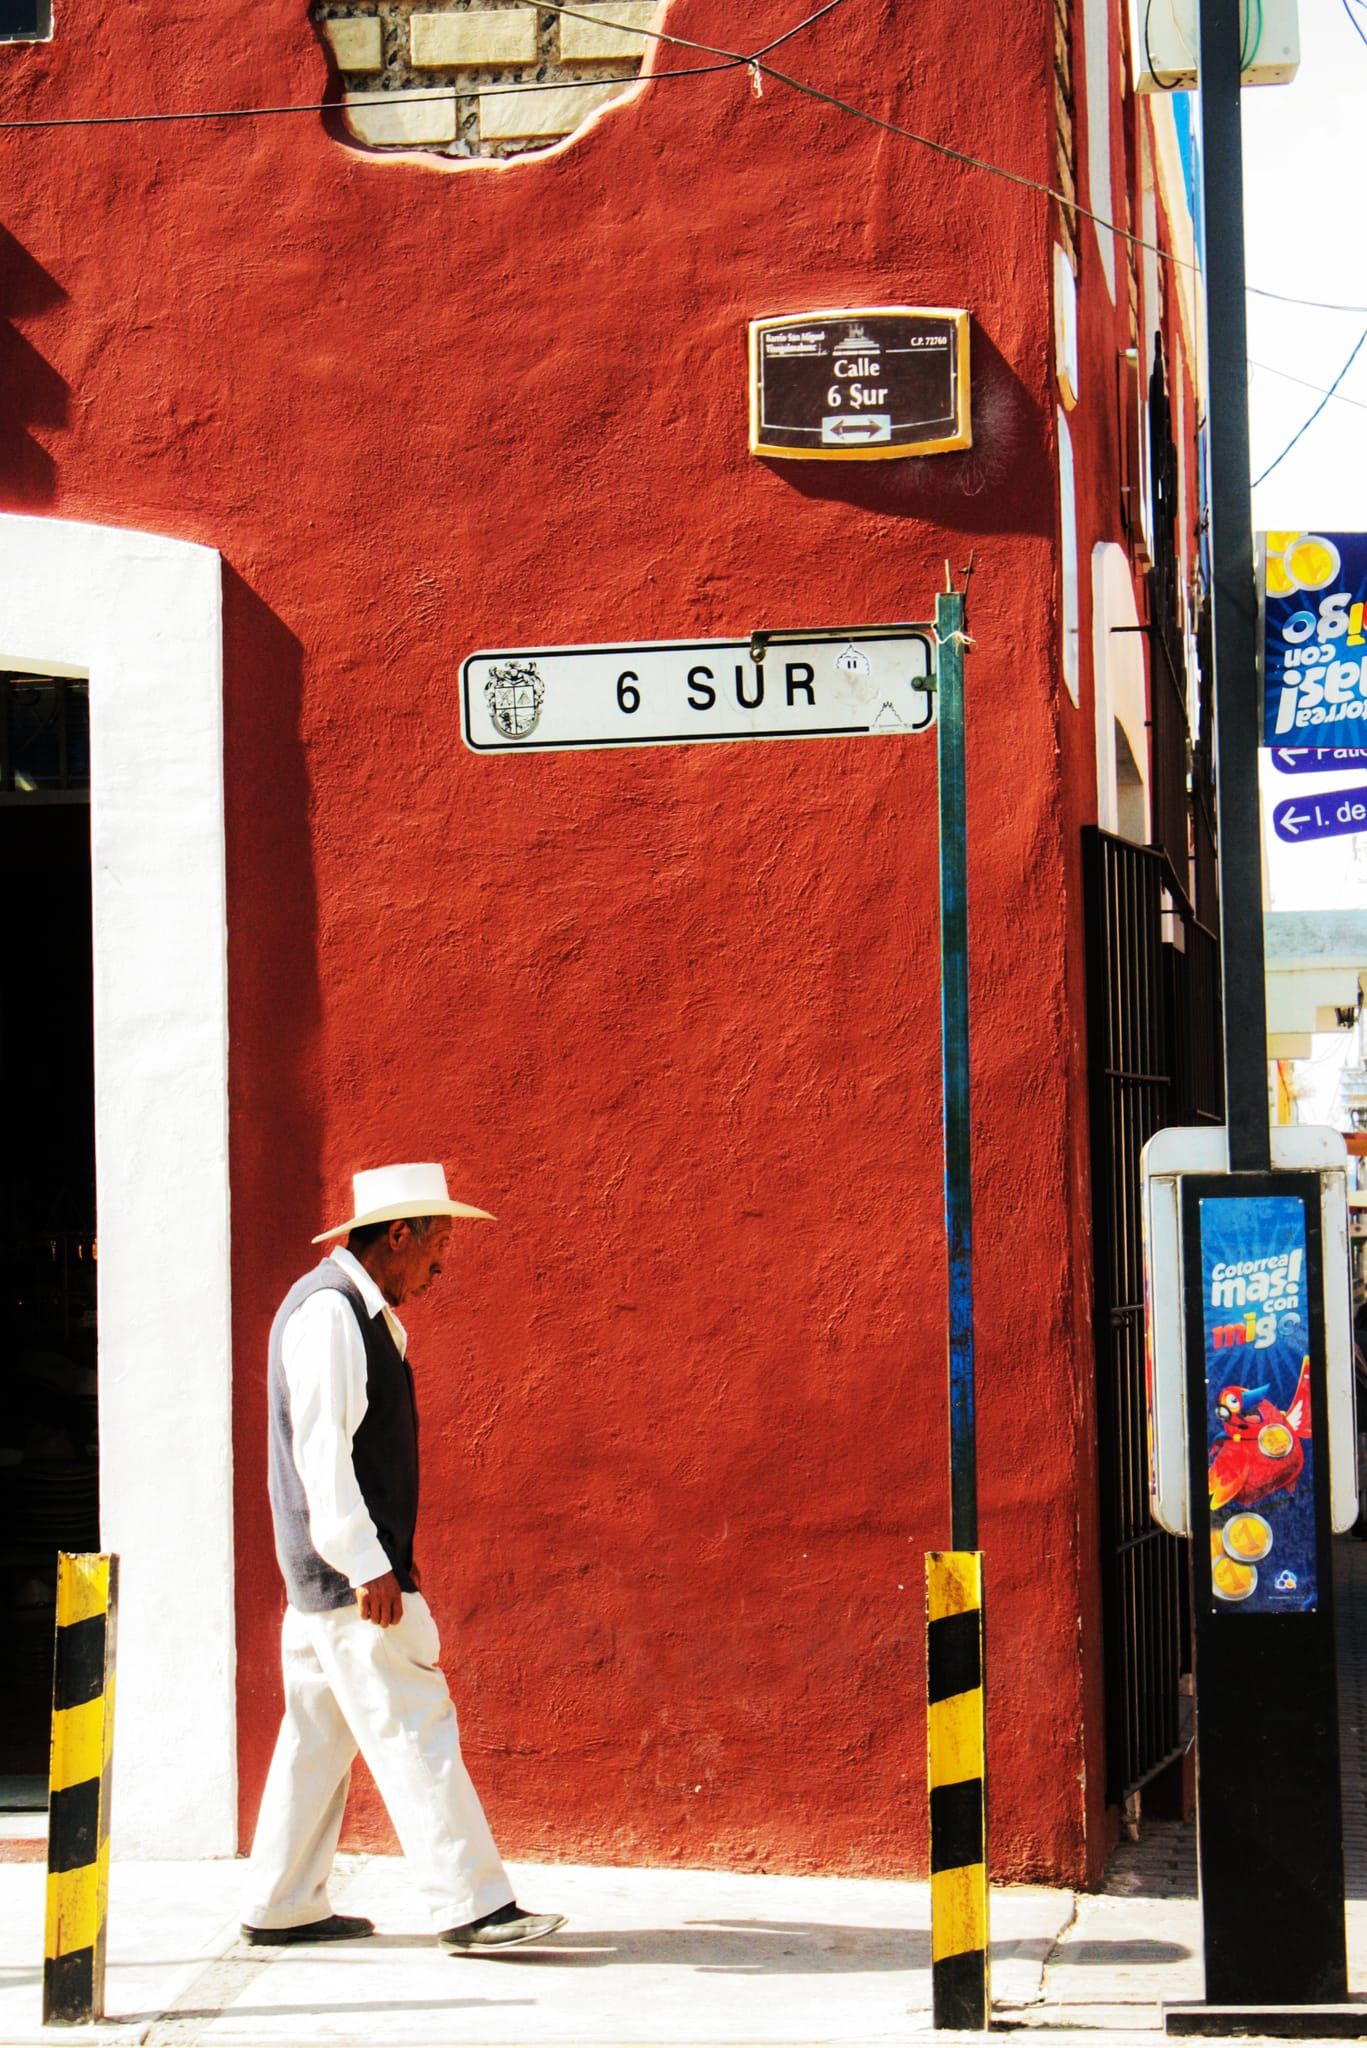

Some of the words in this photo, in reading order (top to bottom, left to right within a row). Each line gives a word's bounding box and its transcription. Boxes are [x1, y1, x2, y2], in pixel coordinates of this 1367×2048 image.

[833, 358, 881, 378] Calle
[827, 385, 842, 408] 6
[850, 383, 888, 409] Sur
[1282, 592, 1367, 647] igo
[1284, 644, 1337, 668] con
[616, 670, 641, 714] 6
[687, 662, 817, 711] SUR
[1274, 656, 1367, 735] as!
[1336, 800, 1367, 822] de
[1211, 1253, 1289, 1282] Cotorrea
[1211, 1248, 1303, 1308] mas!
[1263, 1295, 1299, 1313] con
[1211, 1312, 1301, 1349] migo
